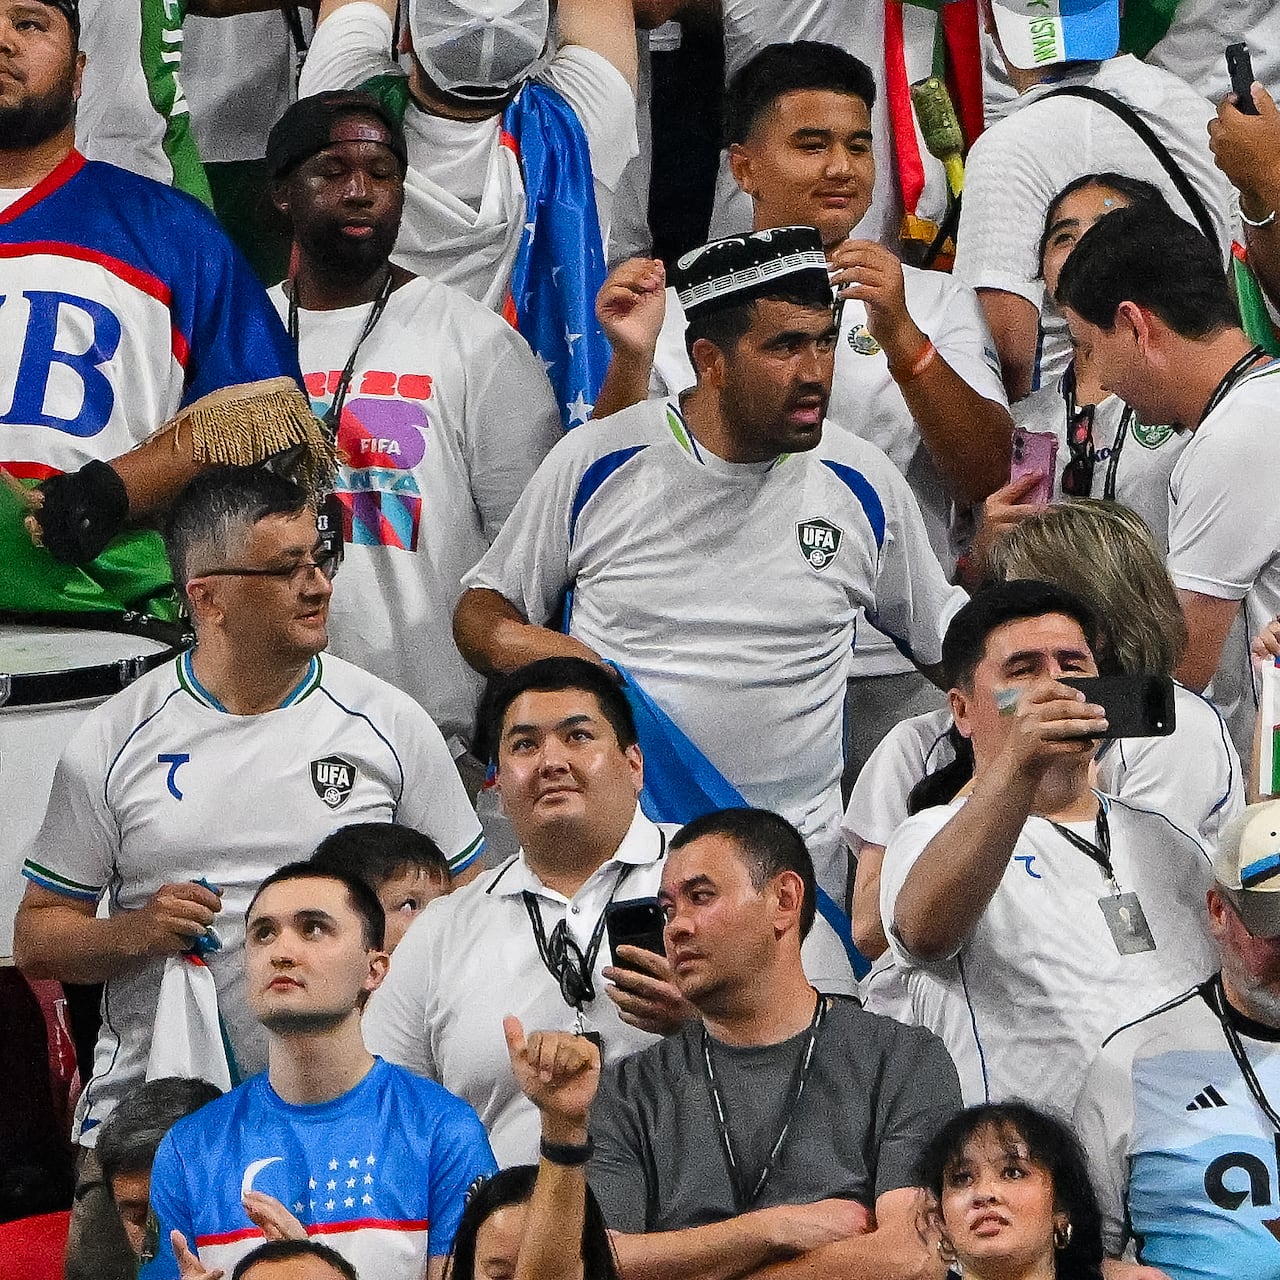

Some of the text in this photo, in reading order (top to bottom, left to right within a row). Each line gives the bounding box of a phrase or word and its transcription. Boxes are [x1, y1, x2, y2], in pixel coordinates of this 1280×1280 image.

[360, 438, 402, 456] FIFA
[803, 526, 835, 550] UFA
[317, 763, 350, 787] UFA
